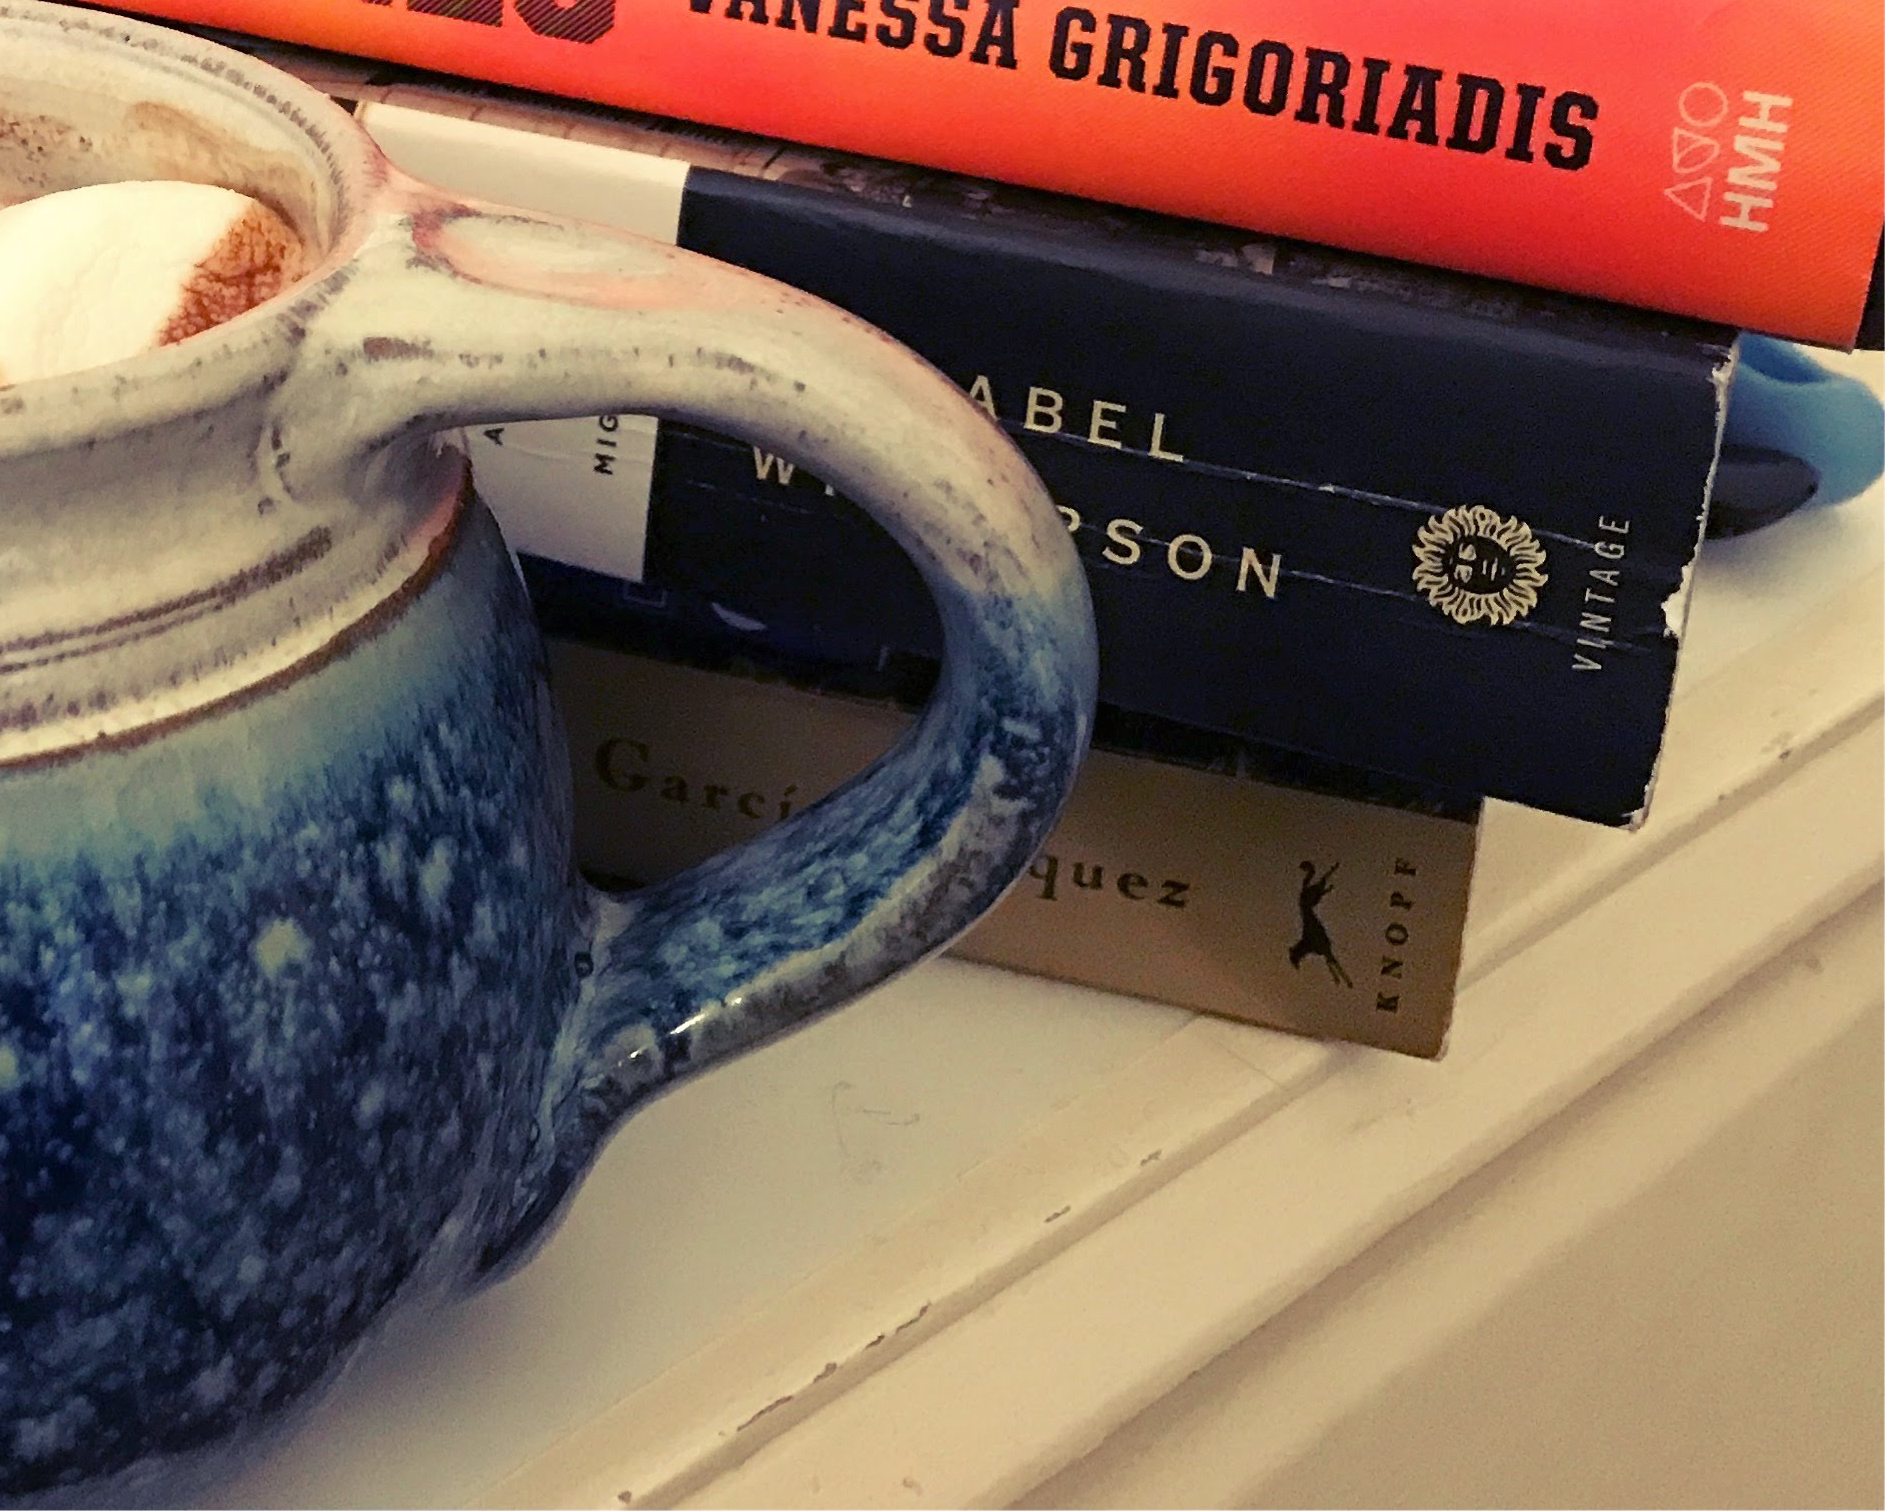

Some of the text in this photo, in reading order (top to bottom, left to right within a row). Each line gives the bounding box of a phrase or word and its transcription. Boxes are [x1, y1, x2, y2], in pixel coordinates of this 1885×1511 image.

[1049, 4, 1600, 172] GRIGORIADIS
[1718, 89, 1794, 232] HMH
[1571, 514, 1630, 673] VINTAGE
[1374, 856, 1417, 1014] KNOPF
